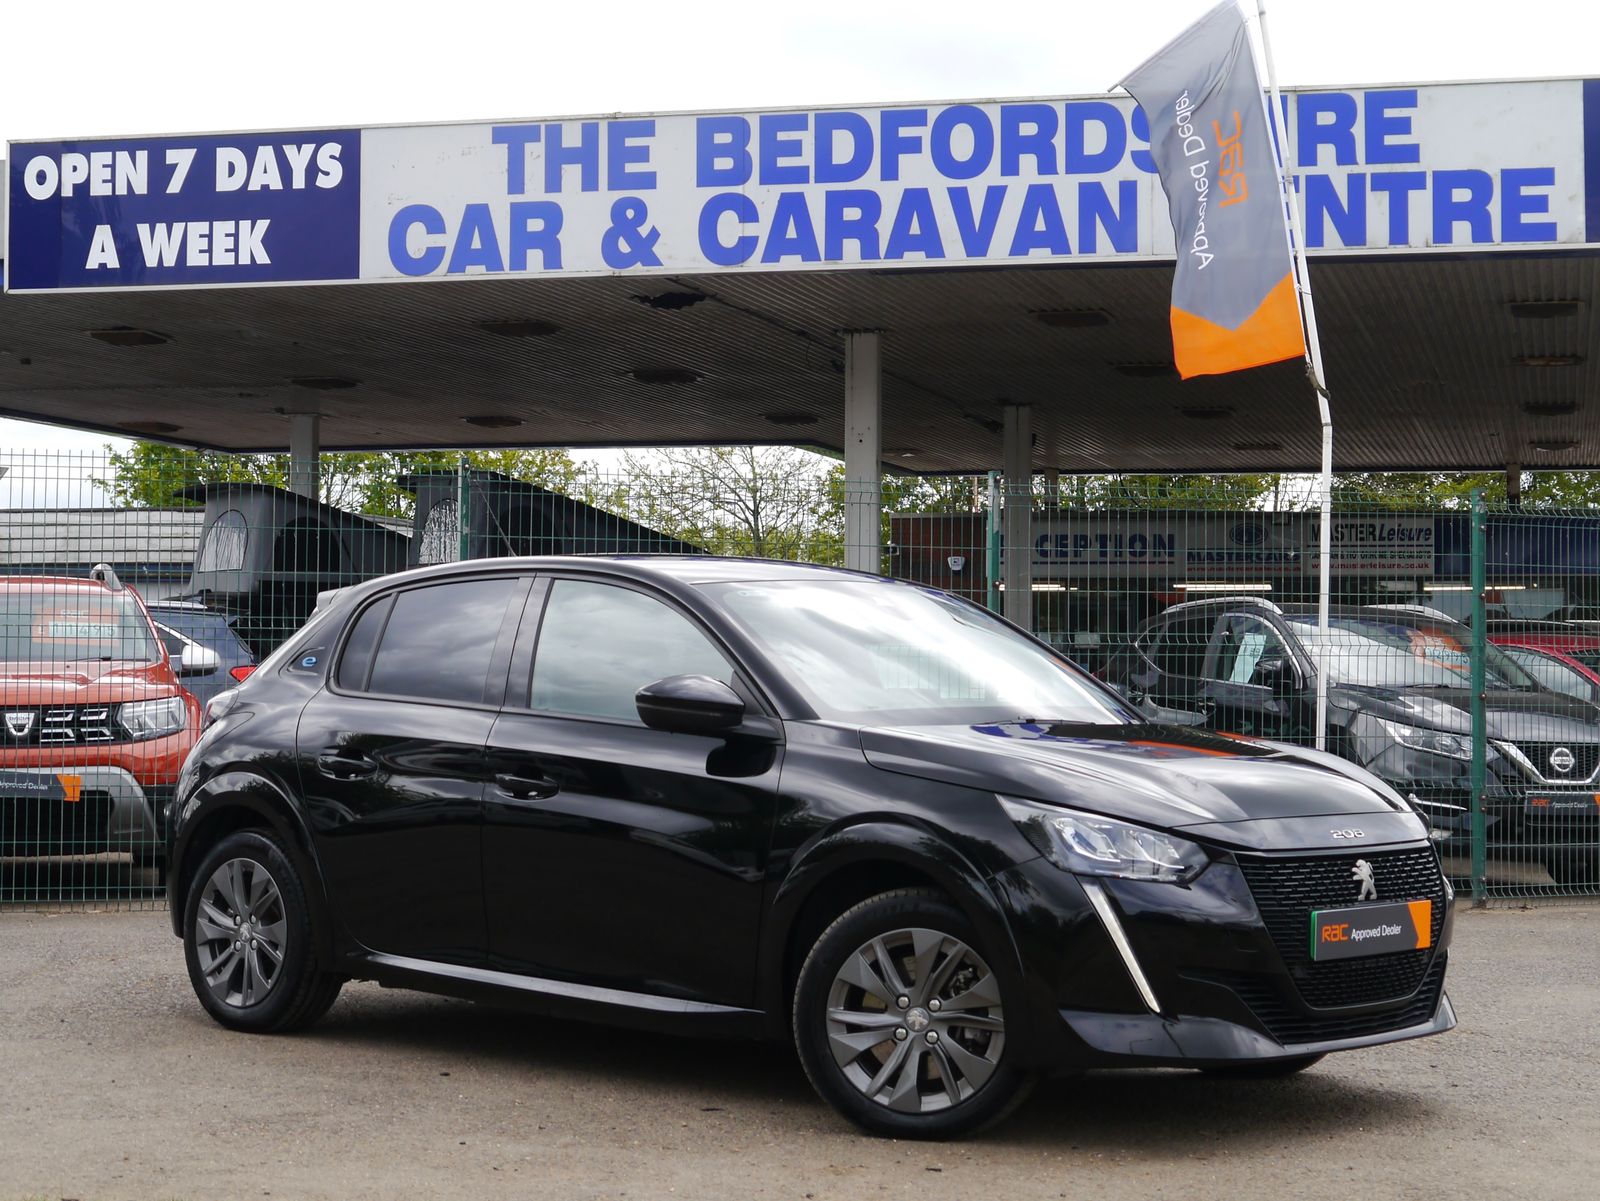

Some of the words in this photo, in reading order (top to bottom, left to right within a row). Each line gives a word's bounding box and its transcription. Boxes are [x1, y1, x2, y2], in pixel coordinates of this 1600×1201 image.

[23, 150, 148, 201] OPEN
[166, 148, 198, 194] 7
[215, 142, 344, 192] DAYS
[491, 119, 657, 195] THE
[85, 224, 120, 270] A
[136, 218, 272, 268] WEEK
[387, 201, 565, 277] CAR
[601, 196, 664, 270] &
[698, 179, 1138, 267] CARAVAN
[1330, 828, 1365, 839] 208
[1351, 925, 1380, 941] Approved
[1381, 923, 1402, 936] Dealer
